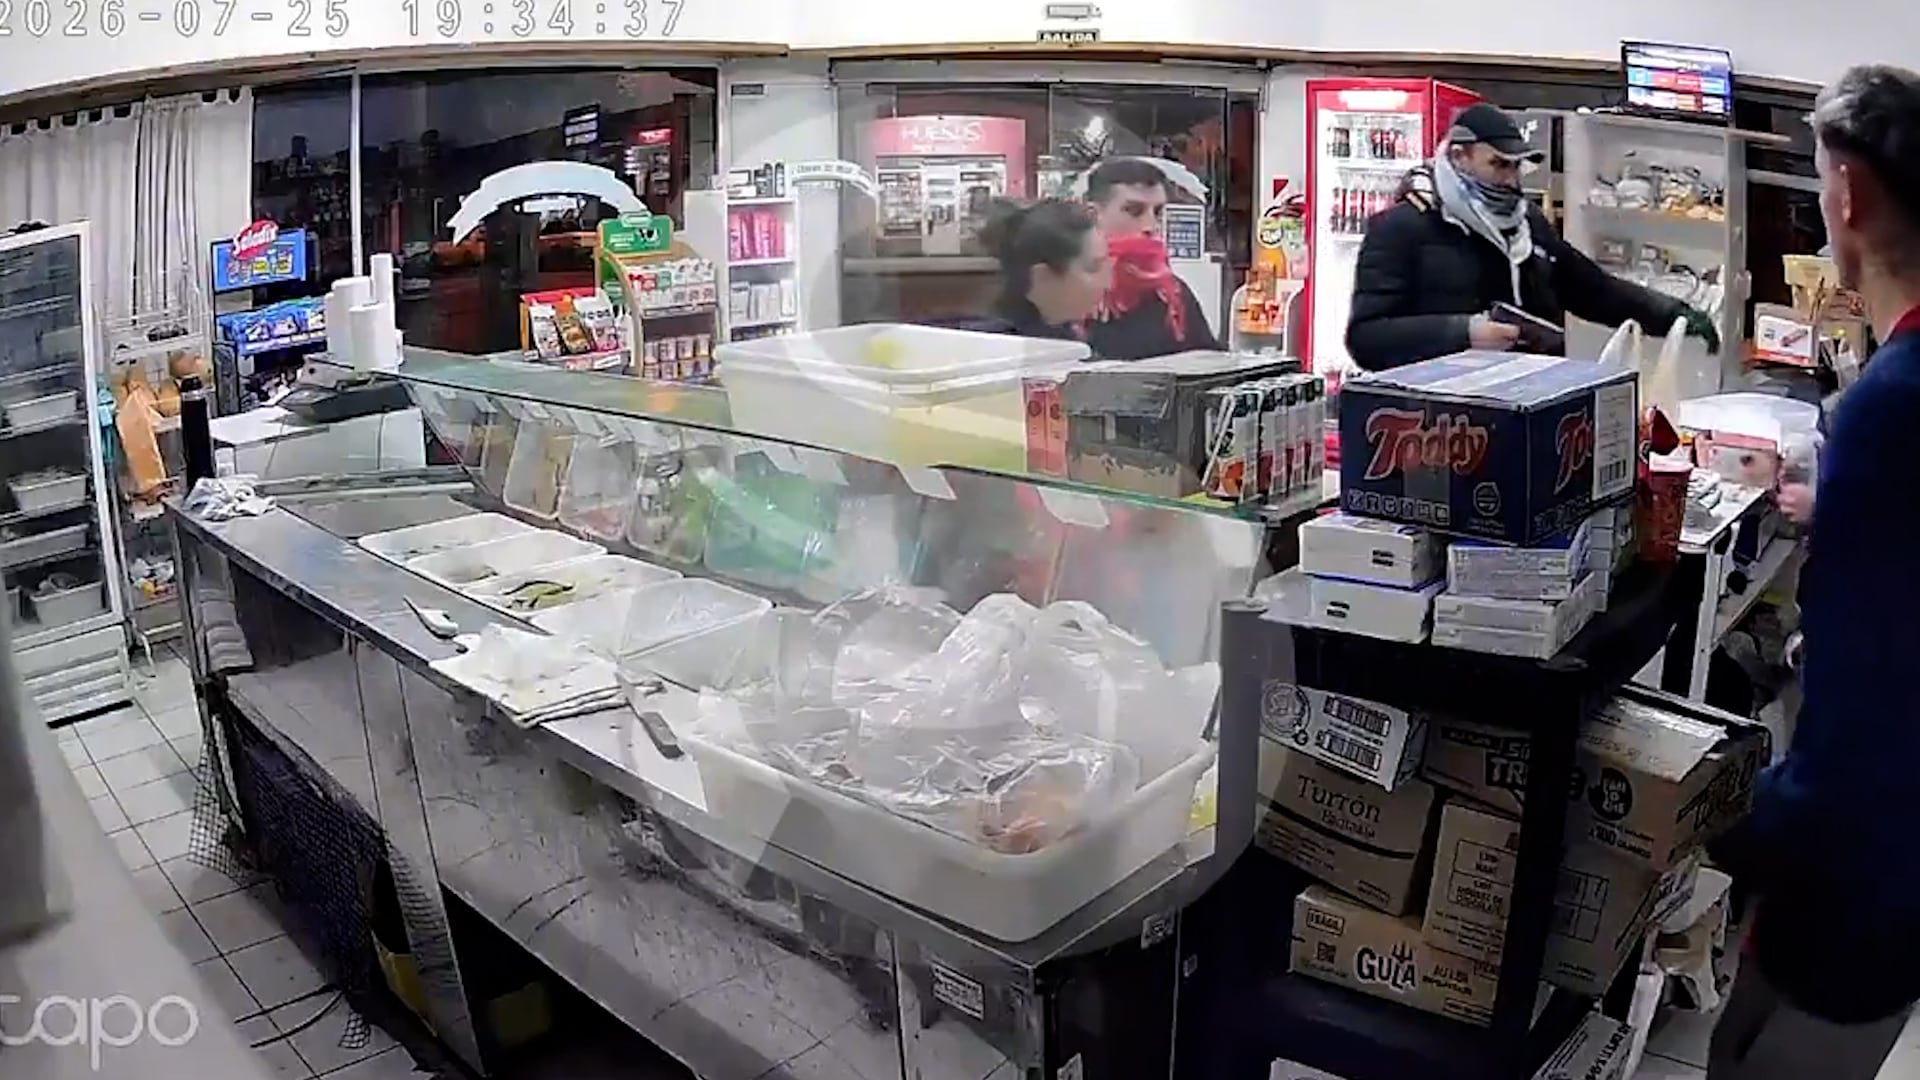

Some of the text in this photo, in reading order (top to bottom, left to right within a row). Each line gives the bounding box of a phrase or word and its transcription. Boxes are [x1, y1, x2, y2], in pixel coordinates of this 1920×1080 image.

[1363, 406, 1489, 480] Toddy
[1297, 774, 1381, 823] Turrón
[1357, 947, 1416, 990] GULA
